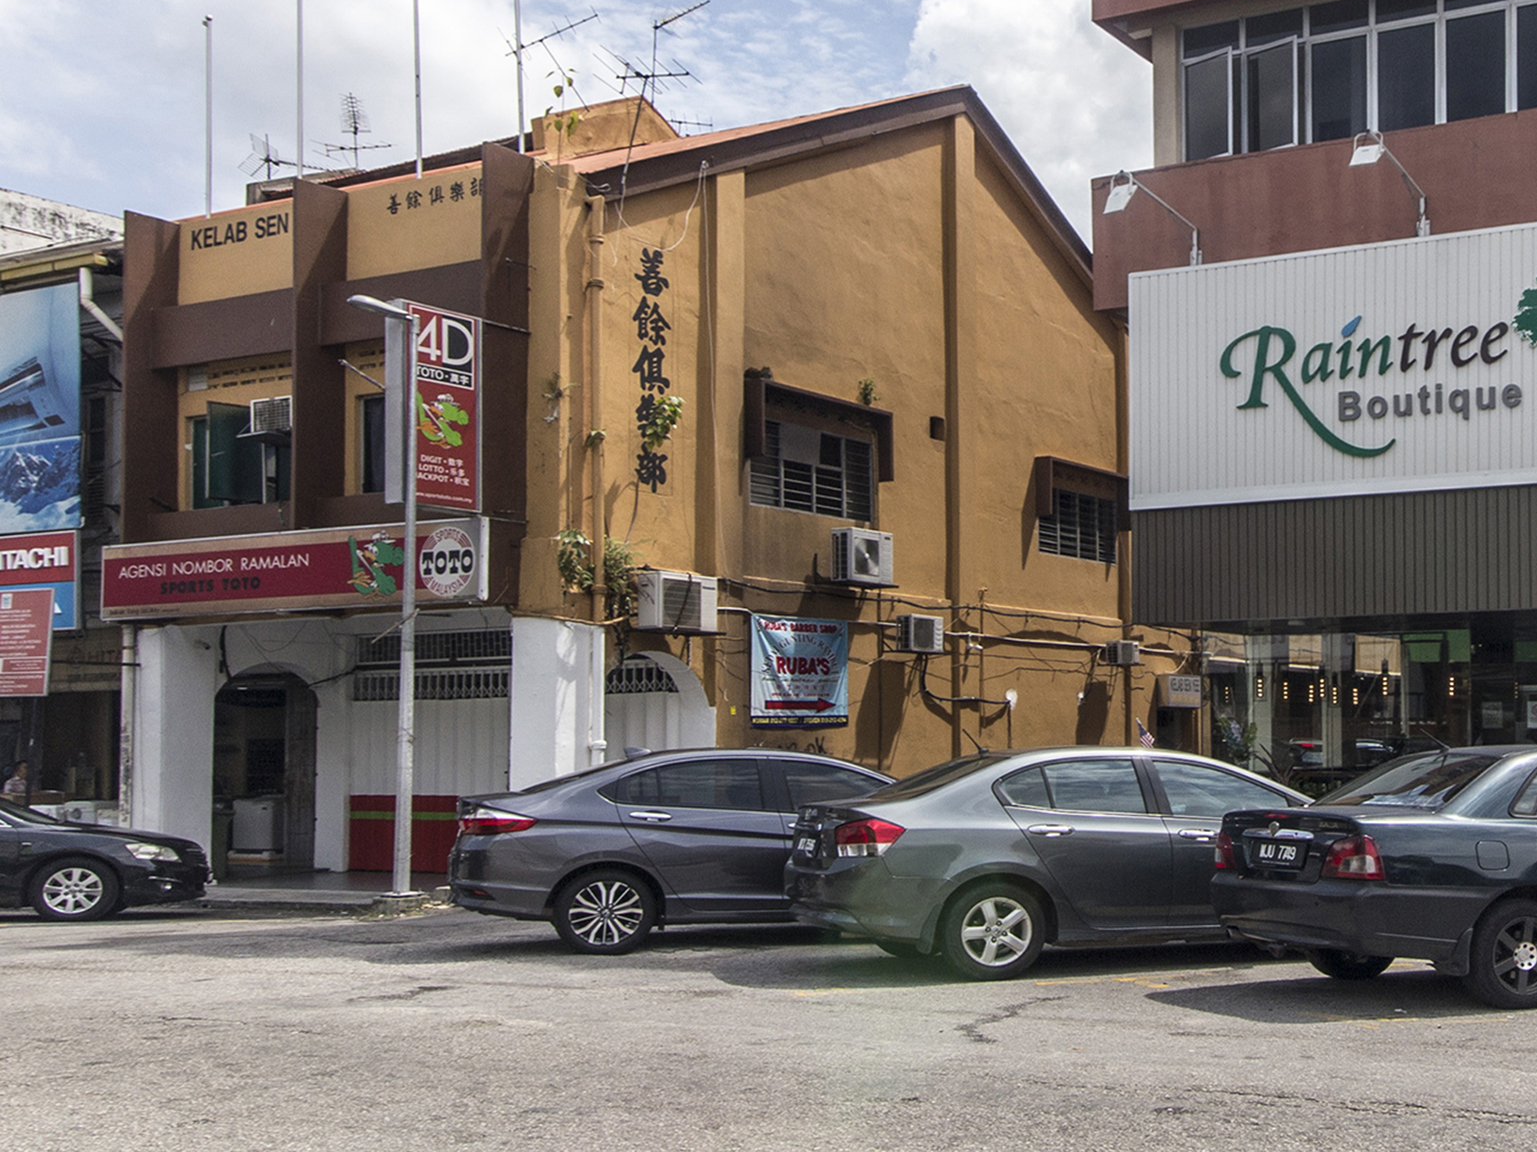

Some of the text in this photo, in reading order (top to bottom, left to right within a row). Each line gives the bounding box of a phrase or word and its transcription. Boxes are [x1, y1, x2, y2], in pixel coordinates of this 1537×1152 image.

[191, 212, 290, 250] KELAB SEN
[417, 314, 474, 366] 4D
[1219, 315, 1511, 459] Raintree
[1336, 383, 1524, 423] Boutique
[418, 463, 445, 474] LOTTO
[420, 454, 443, 464] DIGIT
[417, 472, 449, 483] ACKPOT
[0, 546, 69, 571] TACHI
[119, 552, 310, 580] AGENSI NOMBOR RAMALAN
[421, 548, 474, 576] TOTO
[160, 576, 261, 595] SPORTS TOTO
[775, 656, 831, 676] RUBA'S
